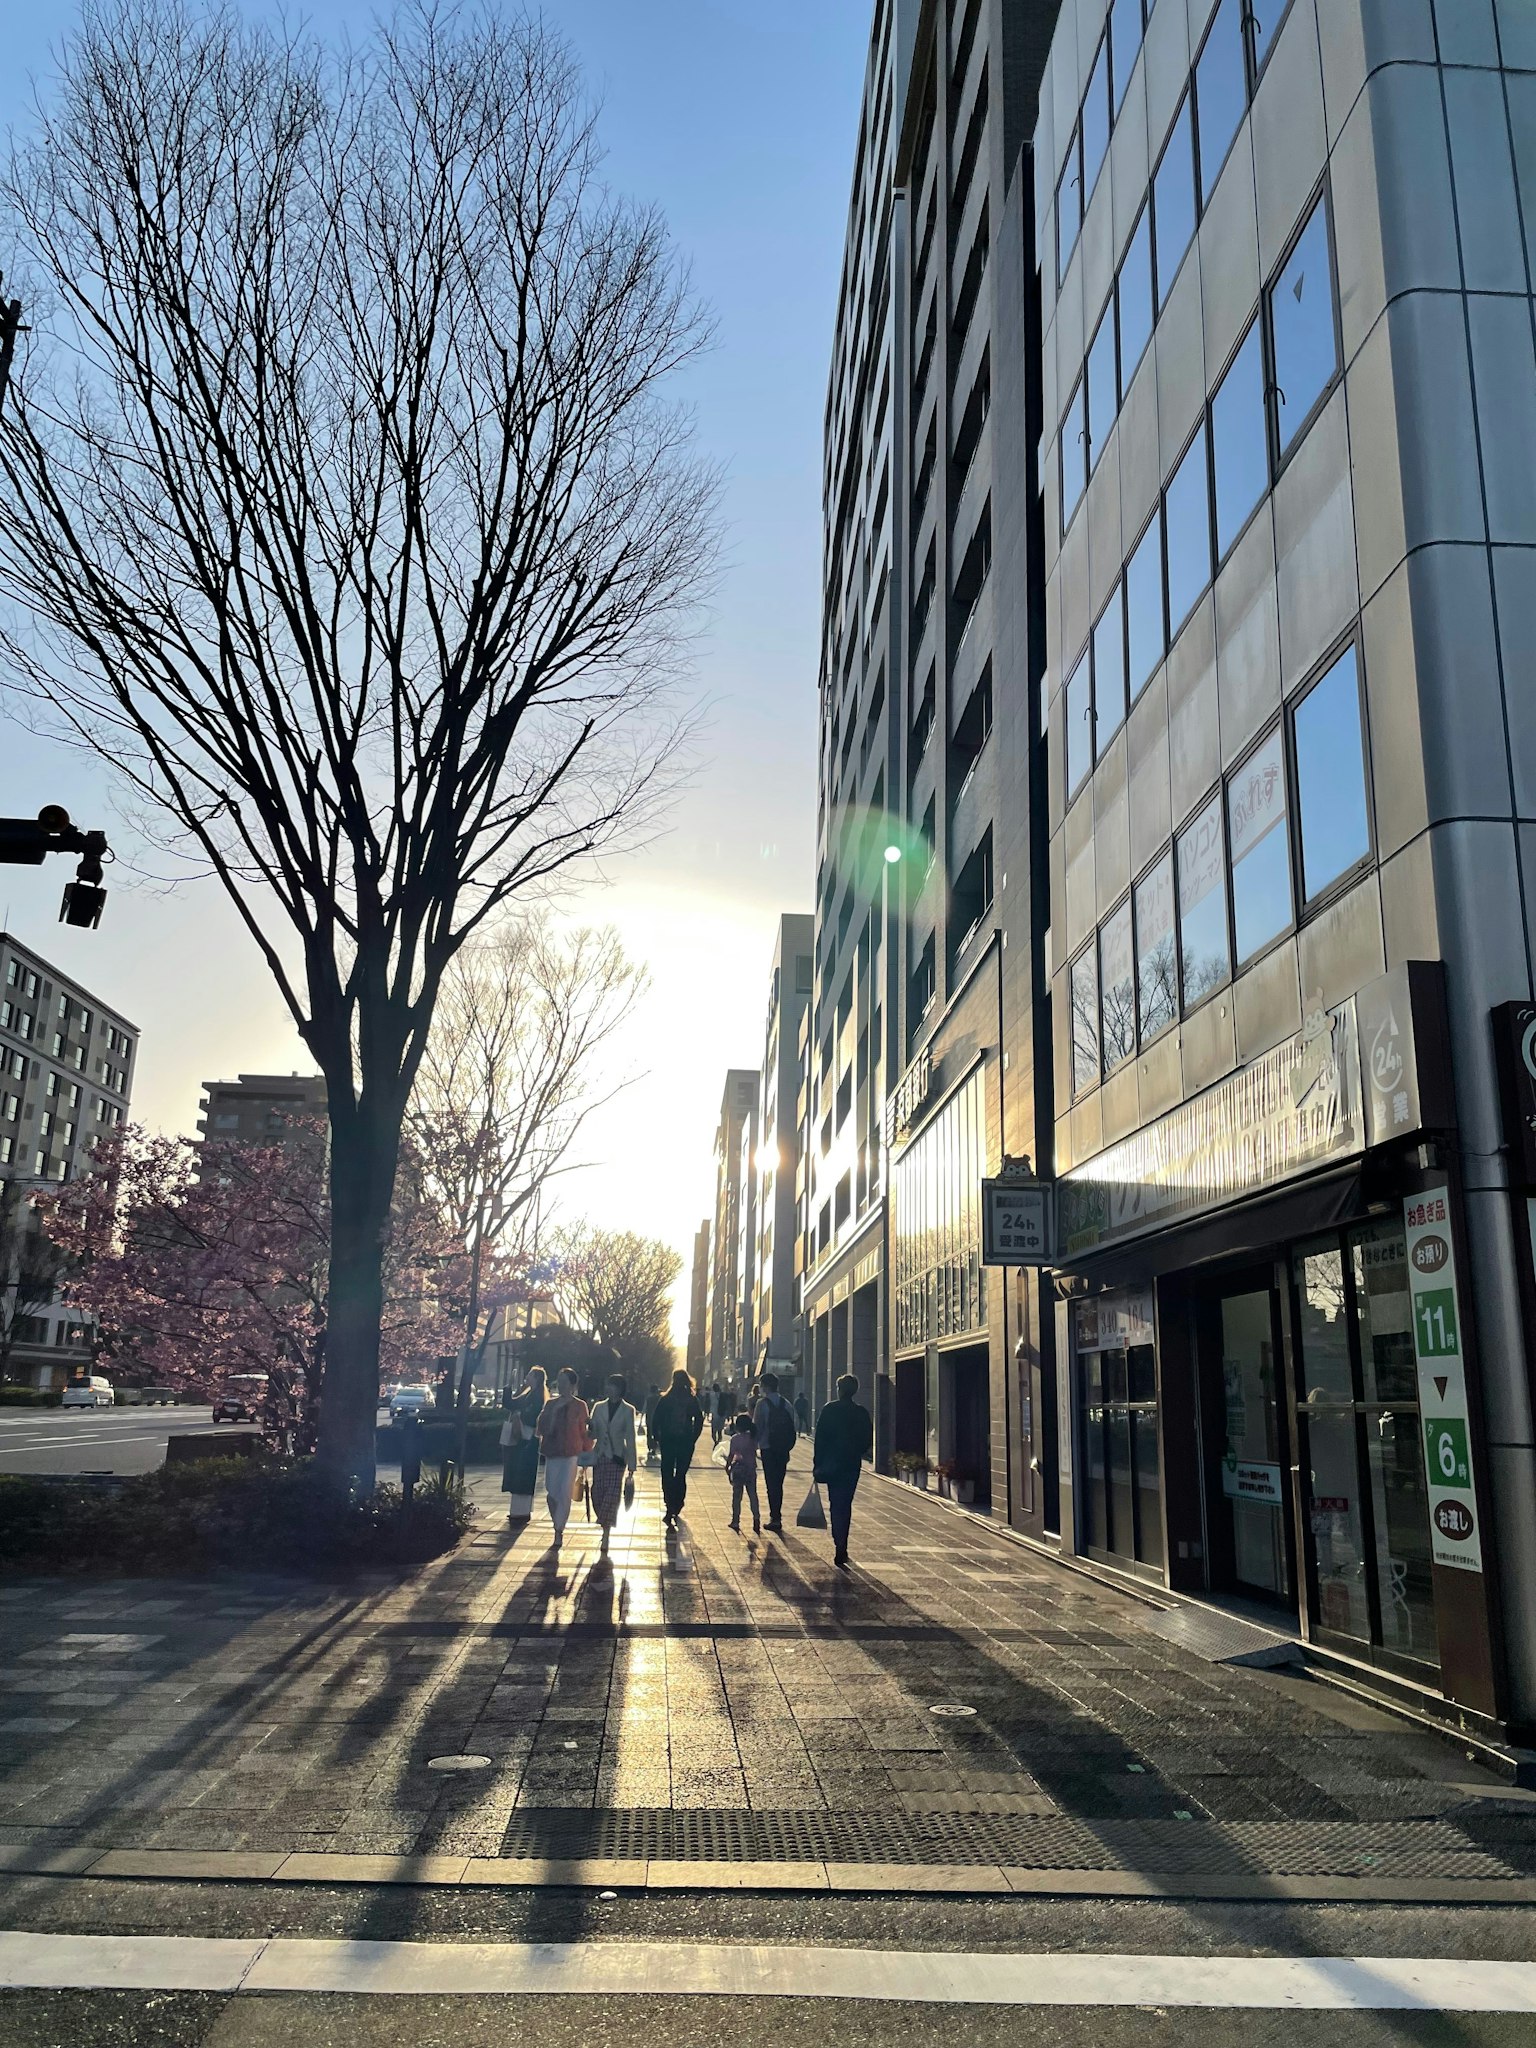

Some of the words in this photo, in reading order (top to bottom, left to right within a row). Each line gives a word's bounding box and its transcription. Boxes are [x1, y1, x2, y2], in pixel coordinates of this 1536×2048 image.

[1375, 1041, 1402, 1077] 24h
[1002, 1213, 1036, 1231] 24h
[1407, 1199, 1446, 1228] お急ぎ品
[1416, 1243, 1443, 1266] お預り
[1439, 1508, 1469, 1532] お渡し
